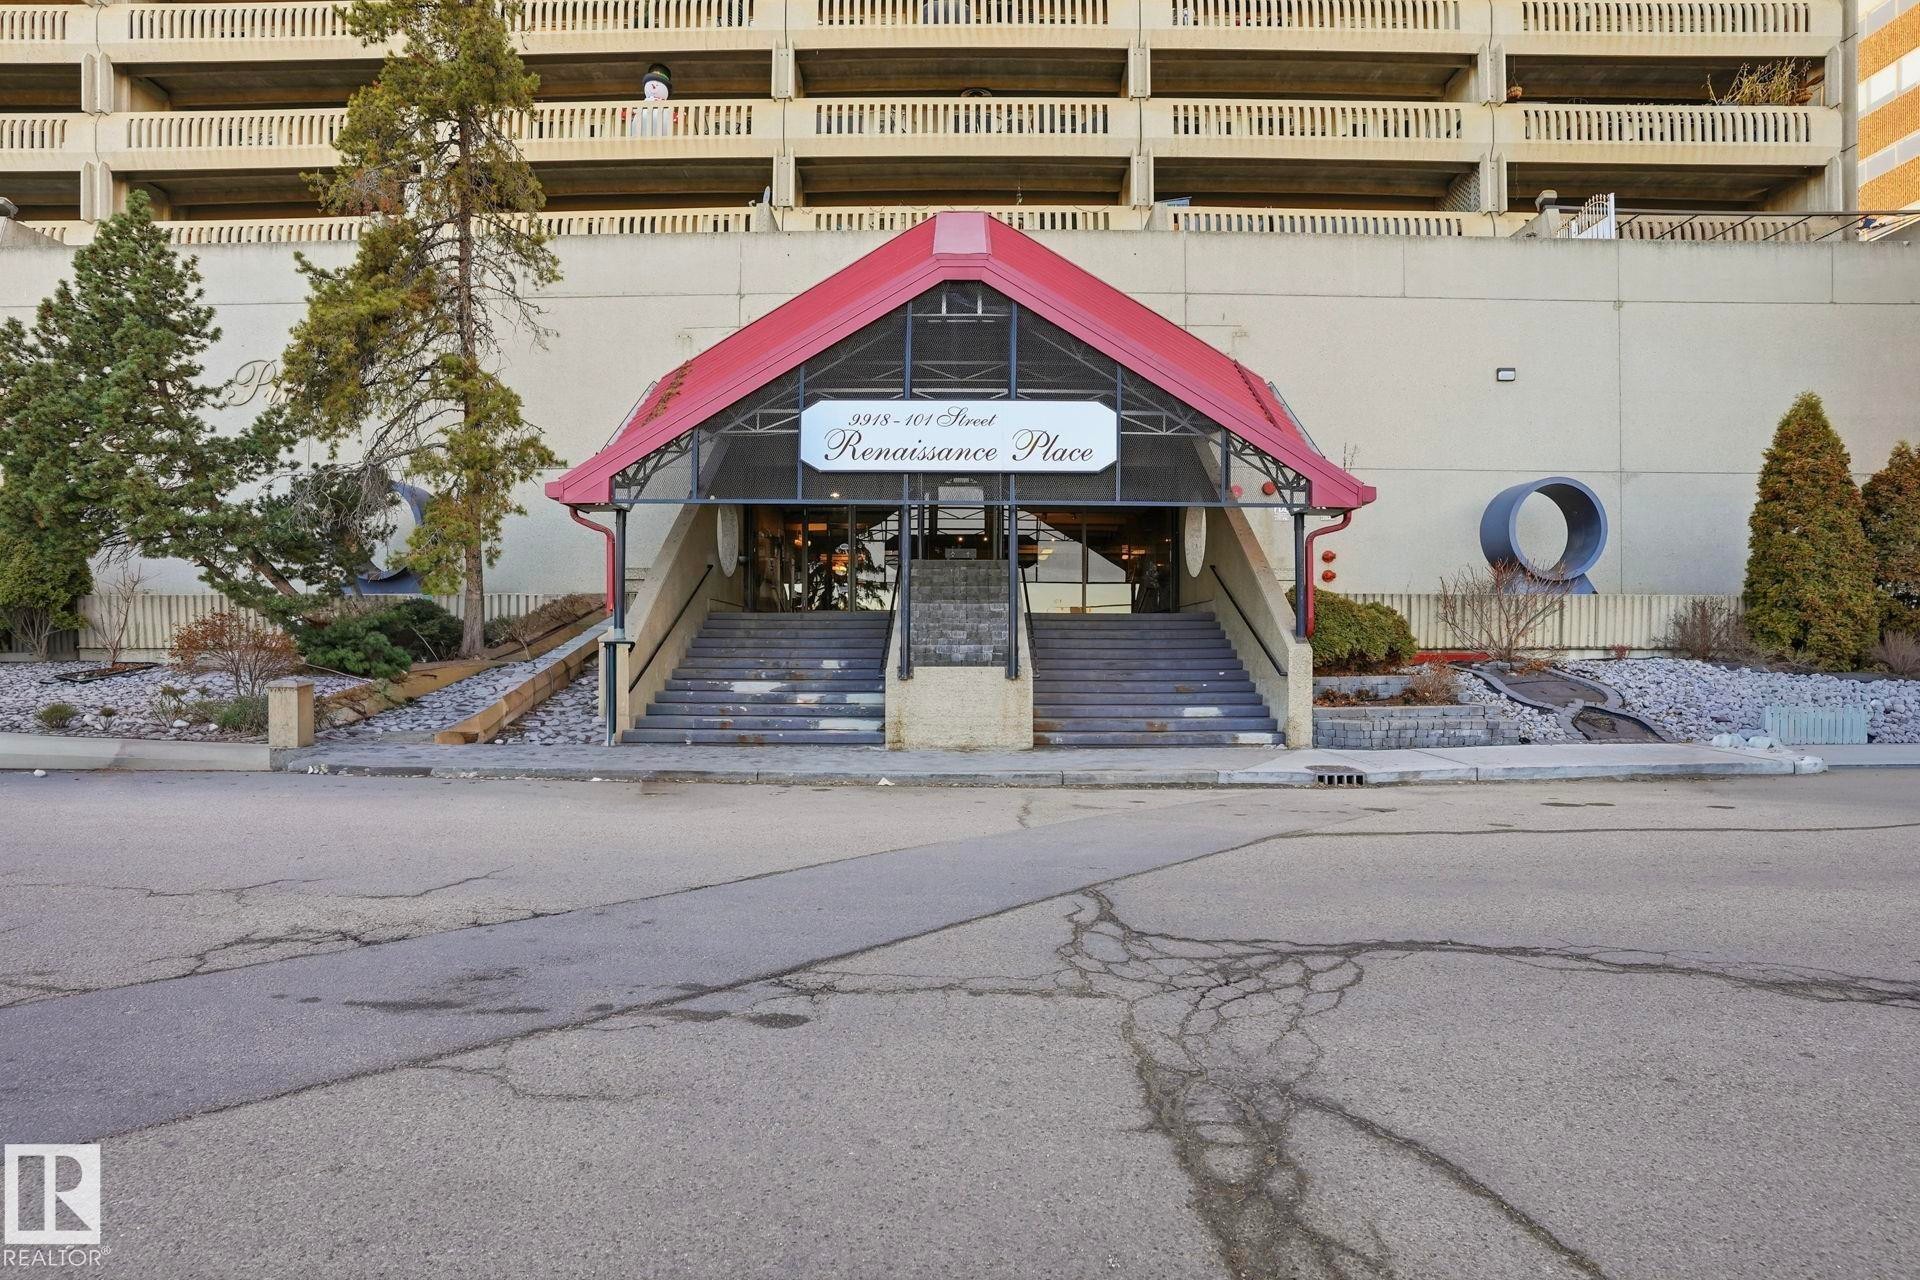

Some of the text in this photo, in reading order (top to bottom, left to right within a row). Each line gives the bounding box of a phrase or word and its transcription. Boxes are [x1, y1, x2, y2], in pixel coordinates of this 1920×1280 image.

[936, 406, 997, 427] Street
[823, 427, 1094, 462] Renaissance Place
